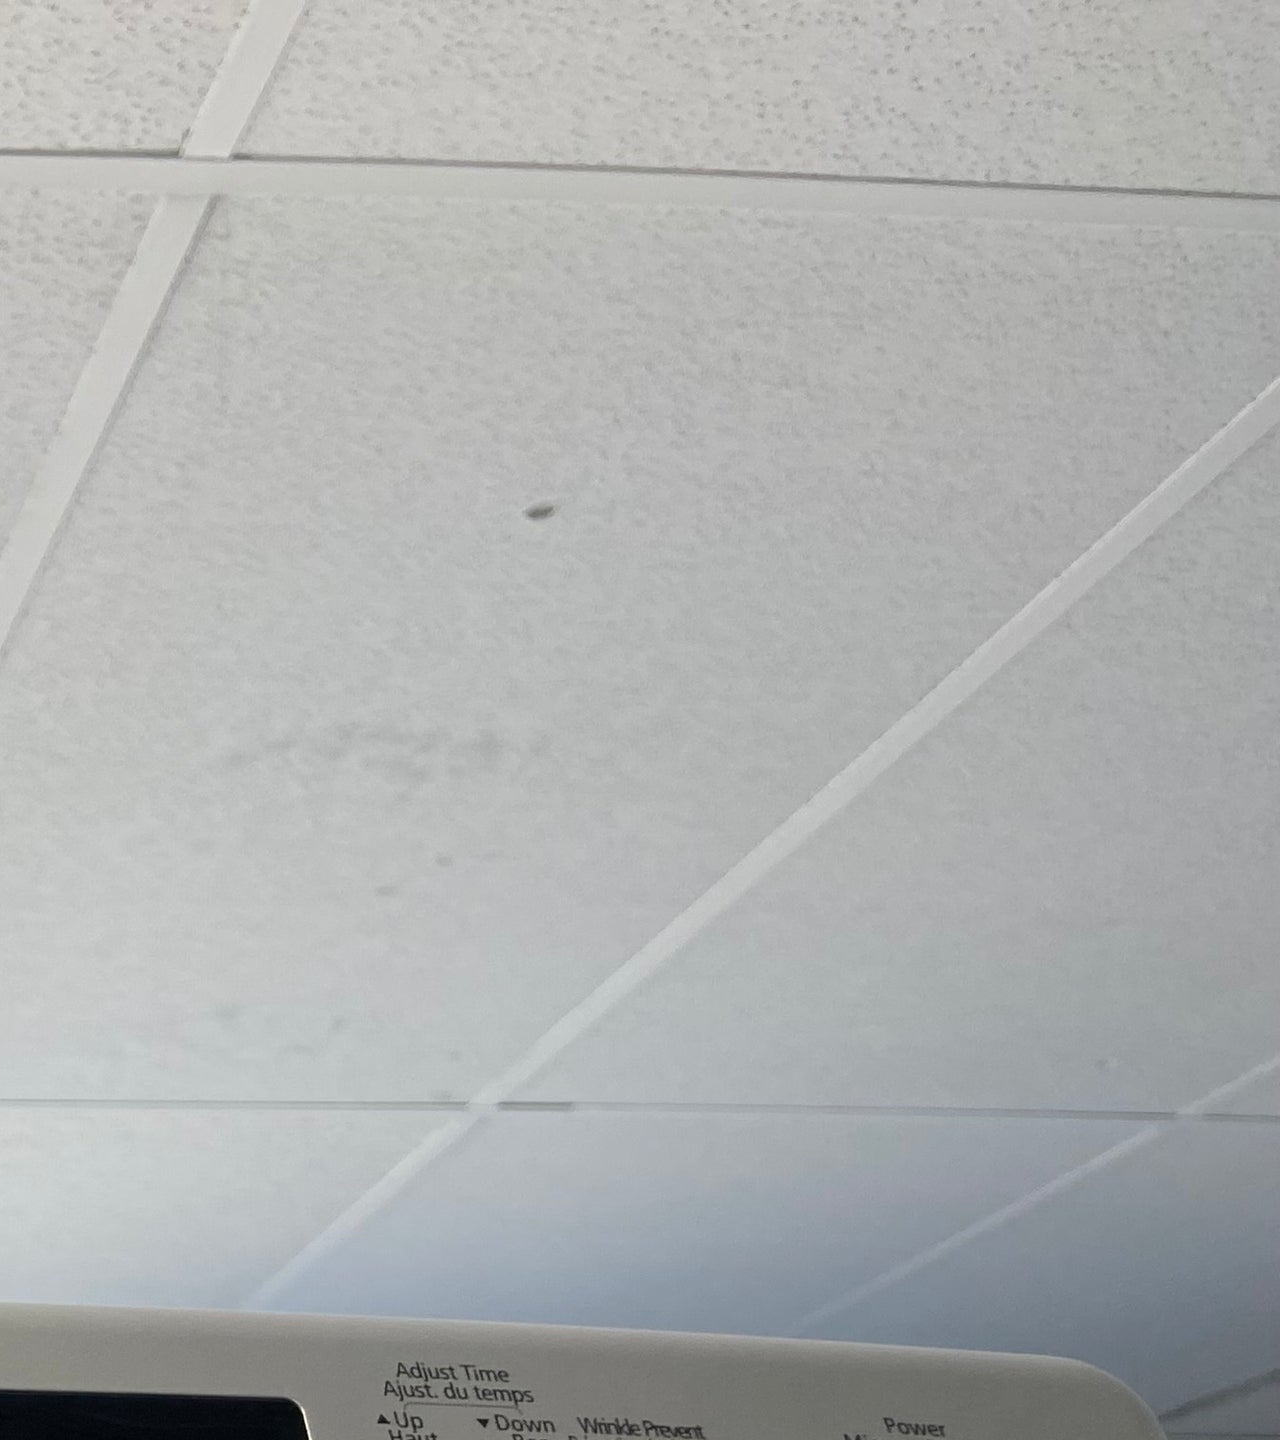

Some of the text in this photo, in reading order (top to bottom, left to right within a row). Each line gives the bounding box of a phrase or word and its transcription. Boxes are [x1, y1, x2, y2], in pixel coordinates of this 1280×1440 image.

[396, 1362, 510, 1383] Adjust Time
[384, 1381, 534, 1404] Ajust. du temps
[394, 1414, 423, 1431] Up
[495, 1415, 556, 1434] Down
[884, 1418, 946, 1437] Power
